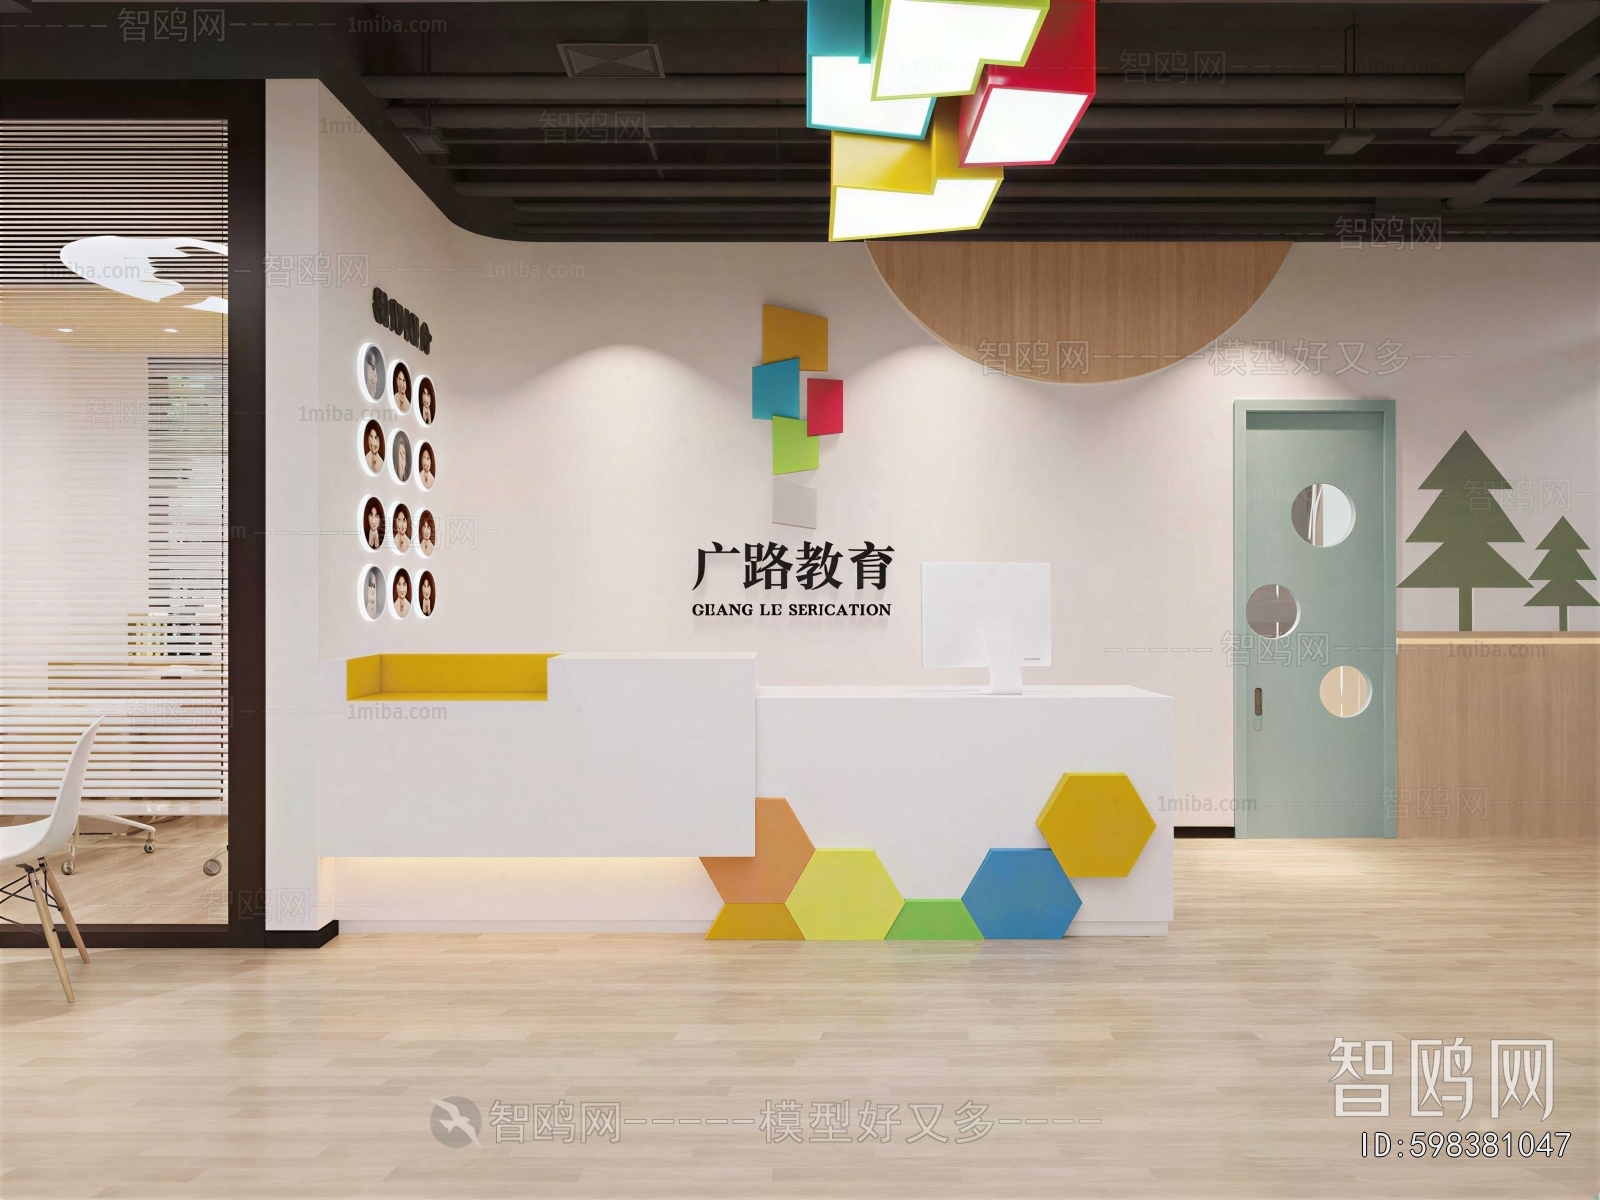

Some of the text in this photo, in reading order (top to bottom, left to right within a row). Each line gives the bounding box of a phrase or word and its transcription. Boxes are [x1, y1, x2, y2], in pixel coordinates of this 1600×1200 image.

[692, 540, 895, 591] 广路教育
[789, 603, 892, 616] SERICATION
